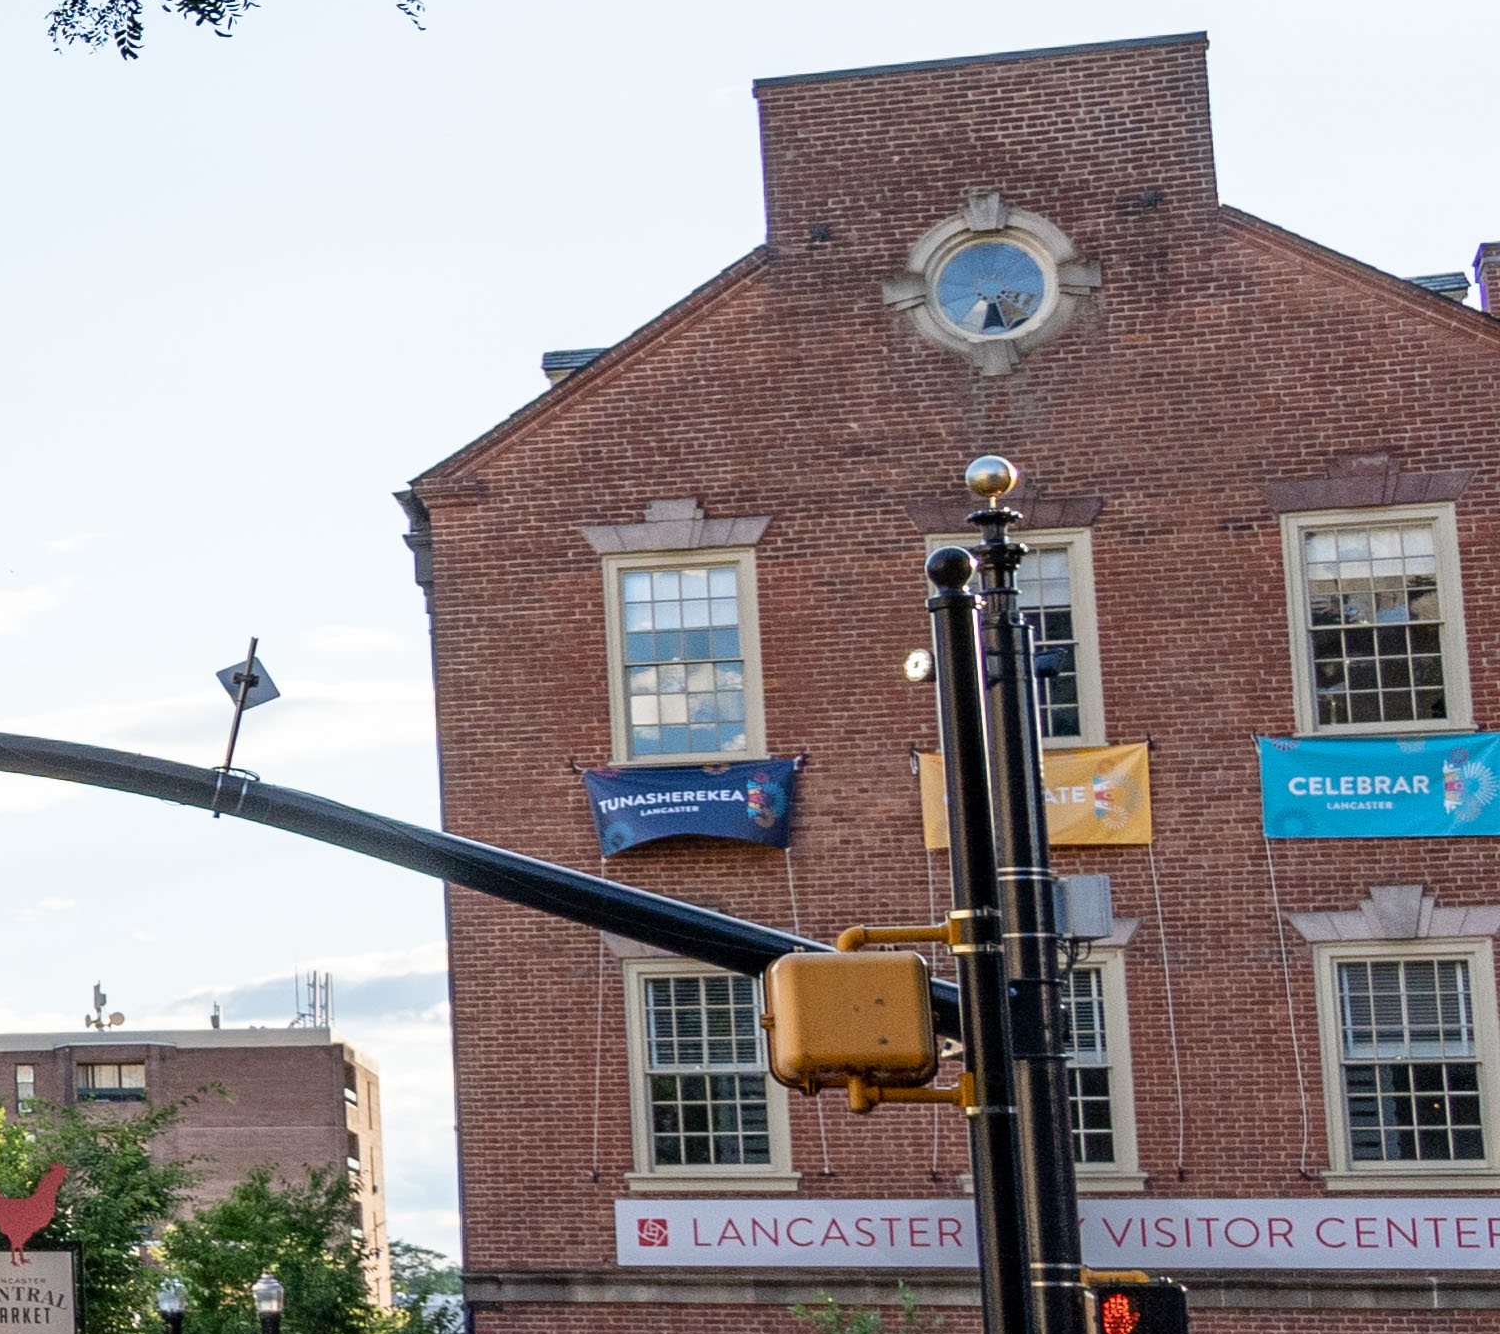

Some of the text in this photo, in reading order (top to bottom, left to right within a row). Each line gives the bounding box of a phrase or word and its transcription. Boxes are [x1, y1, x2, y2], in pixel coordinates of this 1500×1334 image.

[1288, 775, 1430, 795] CELEBRAR
[598, 789, 745, 814] TUNASHEREKEA
[640, 805, 700, 817] LANCASTER
[1326, 801, 1393, 810] LANCASTER
[693, 1217, 963, 1247] LANCASTER
[1102, 1216, 1295, 1248] VISITOR
